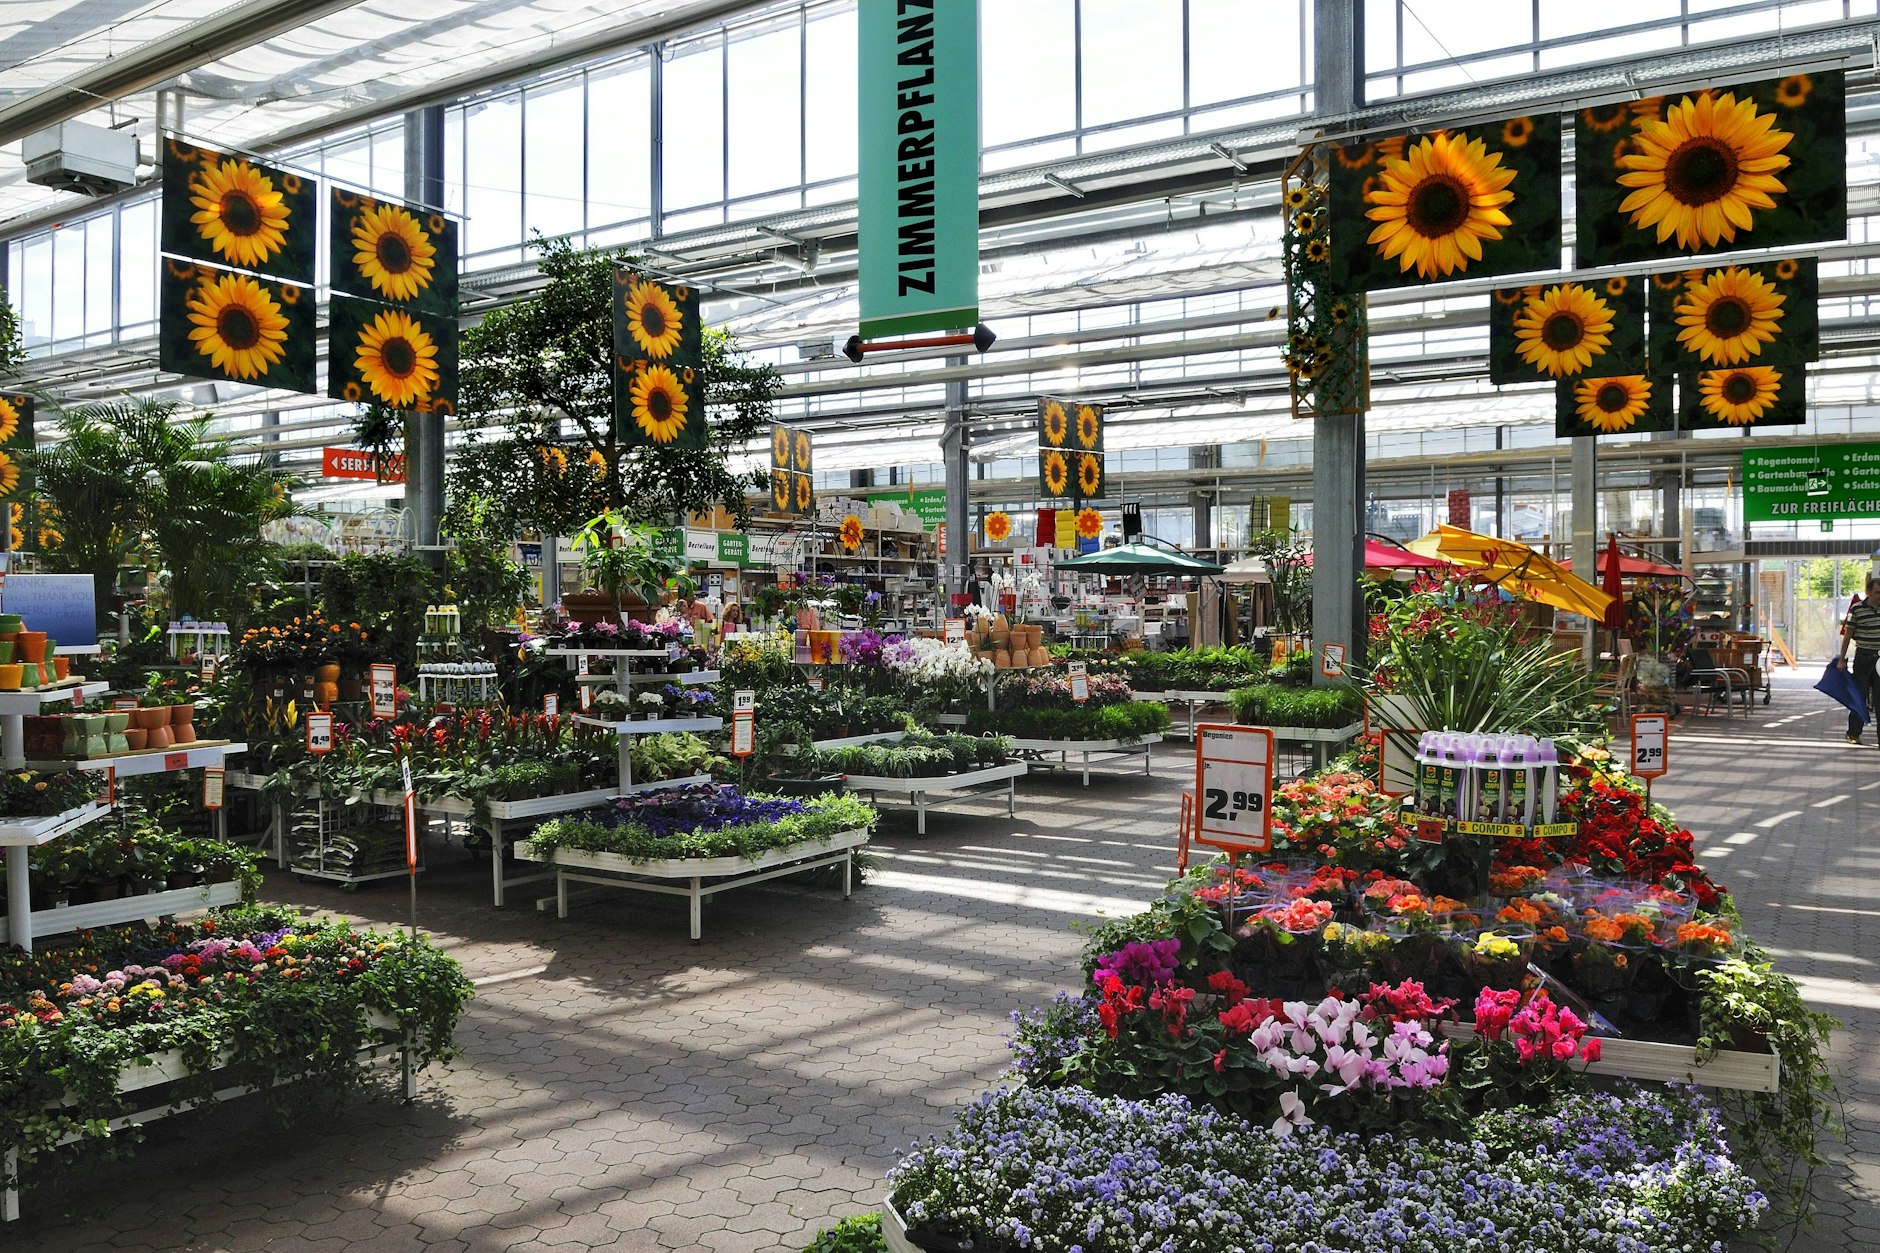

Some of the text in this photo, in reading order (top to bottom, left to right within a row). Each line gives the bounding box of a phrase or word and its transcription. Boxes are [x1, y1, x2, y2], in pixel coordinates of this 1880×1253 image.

[1757, 457, 1820, 467] Regentonnen
[1771, 503, 1799, 514] ZUR
[688, 542, 715, 551] Bestellung
[722, 540, 744, 548] GARTEN-
[6, 578, 48, 589] DANKE
[32, 592, 68, 600] THANK
[71, 592, 92, 600] YOU
[738, 696, 751, 706] 1,99
[1203, 731, 1233, 740] Begonien
[1637, 748, 1662, 763] 2,99
[1205, 788, 1263, 821] 2,99
[1472, 823, 1509, 834] COMPO
[1543, 825, 1568, 835] COMPO
